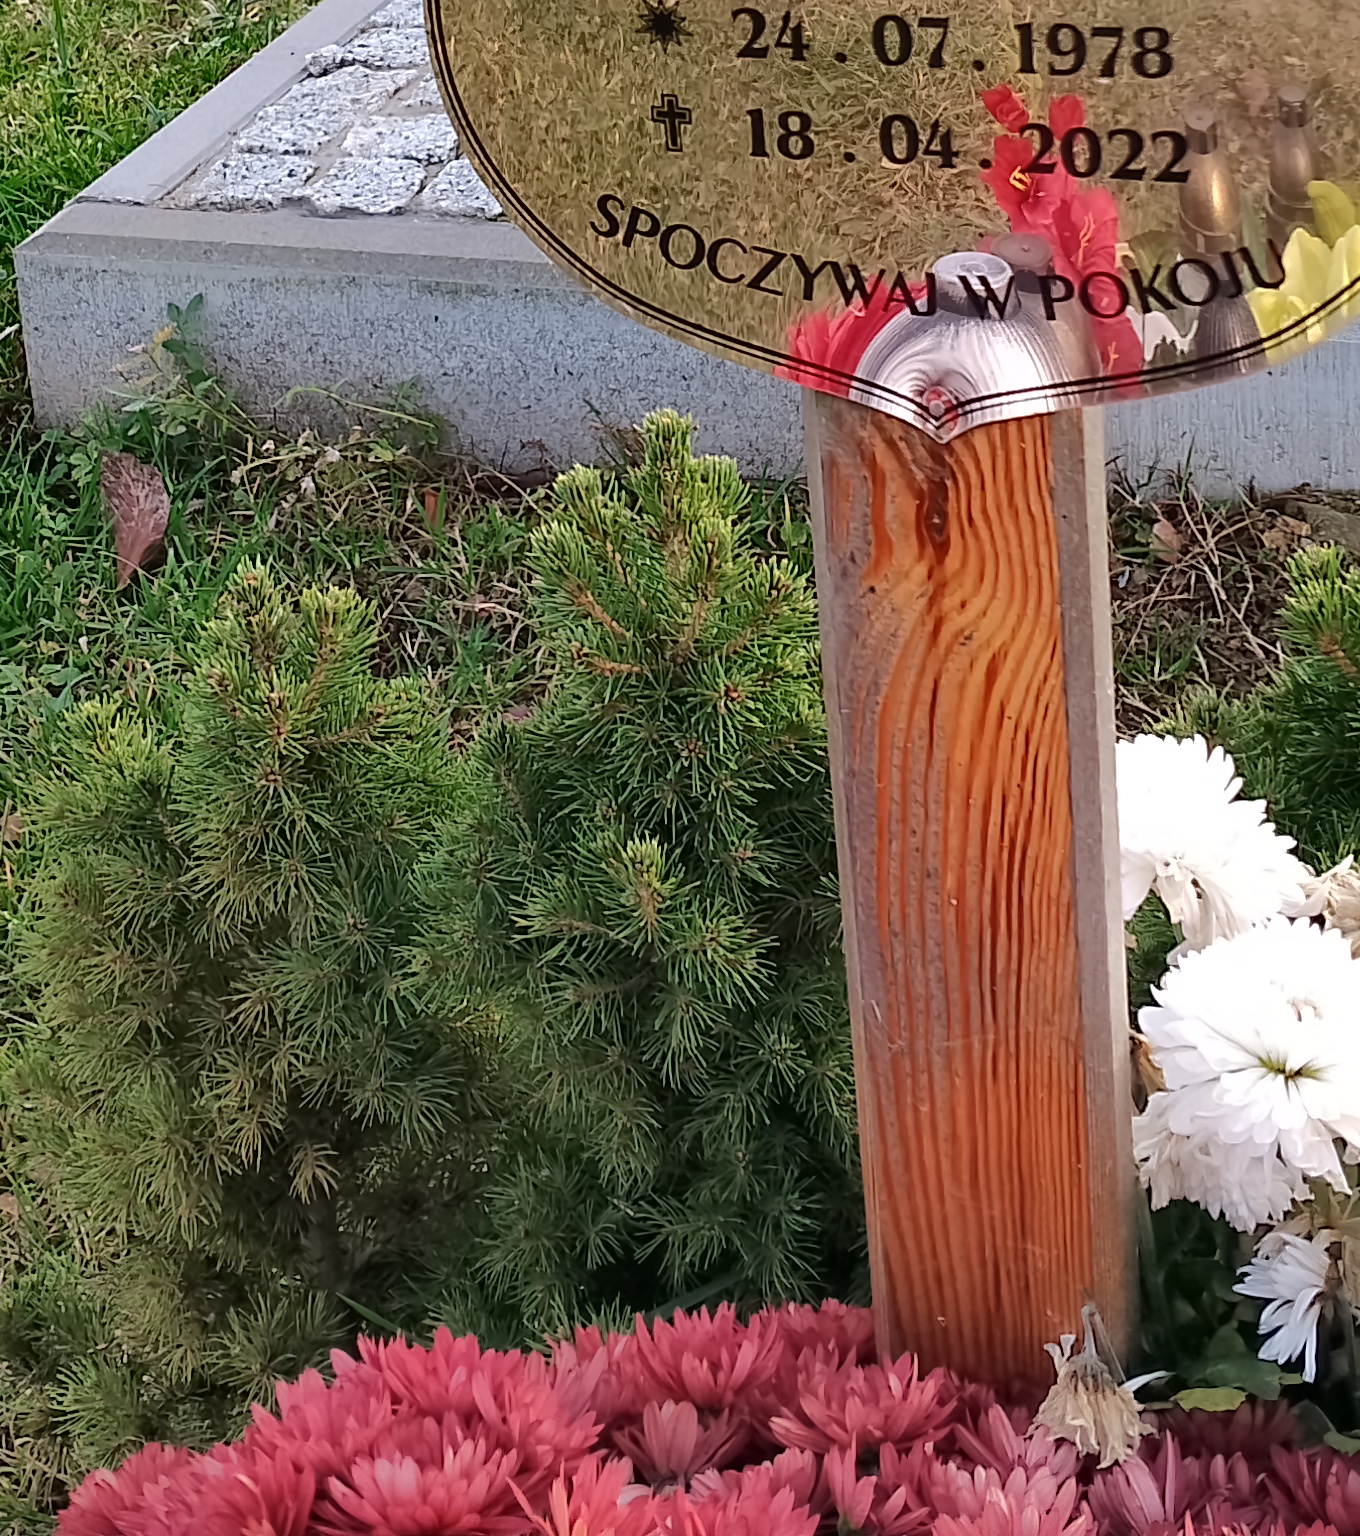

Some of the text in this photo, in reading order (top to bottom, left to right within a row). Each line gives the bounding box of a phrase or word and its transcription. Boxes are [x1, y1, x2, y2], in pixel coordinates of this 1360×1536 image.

[589, 193, 1286, 321] SPOCZYWAJ W POKOJU
